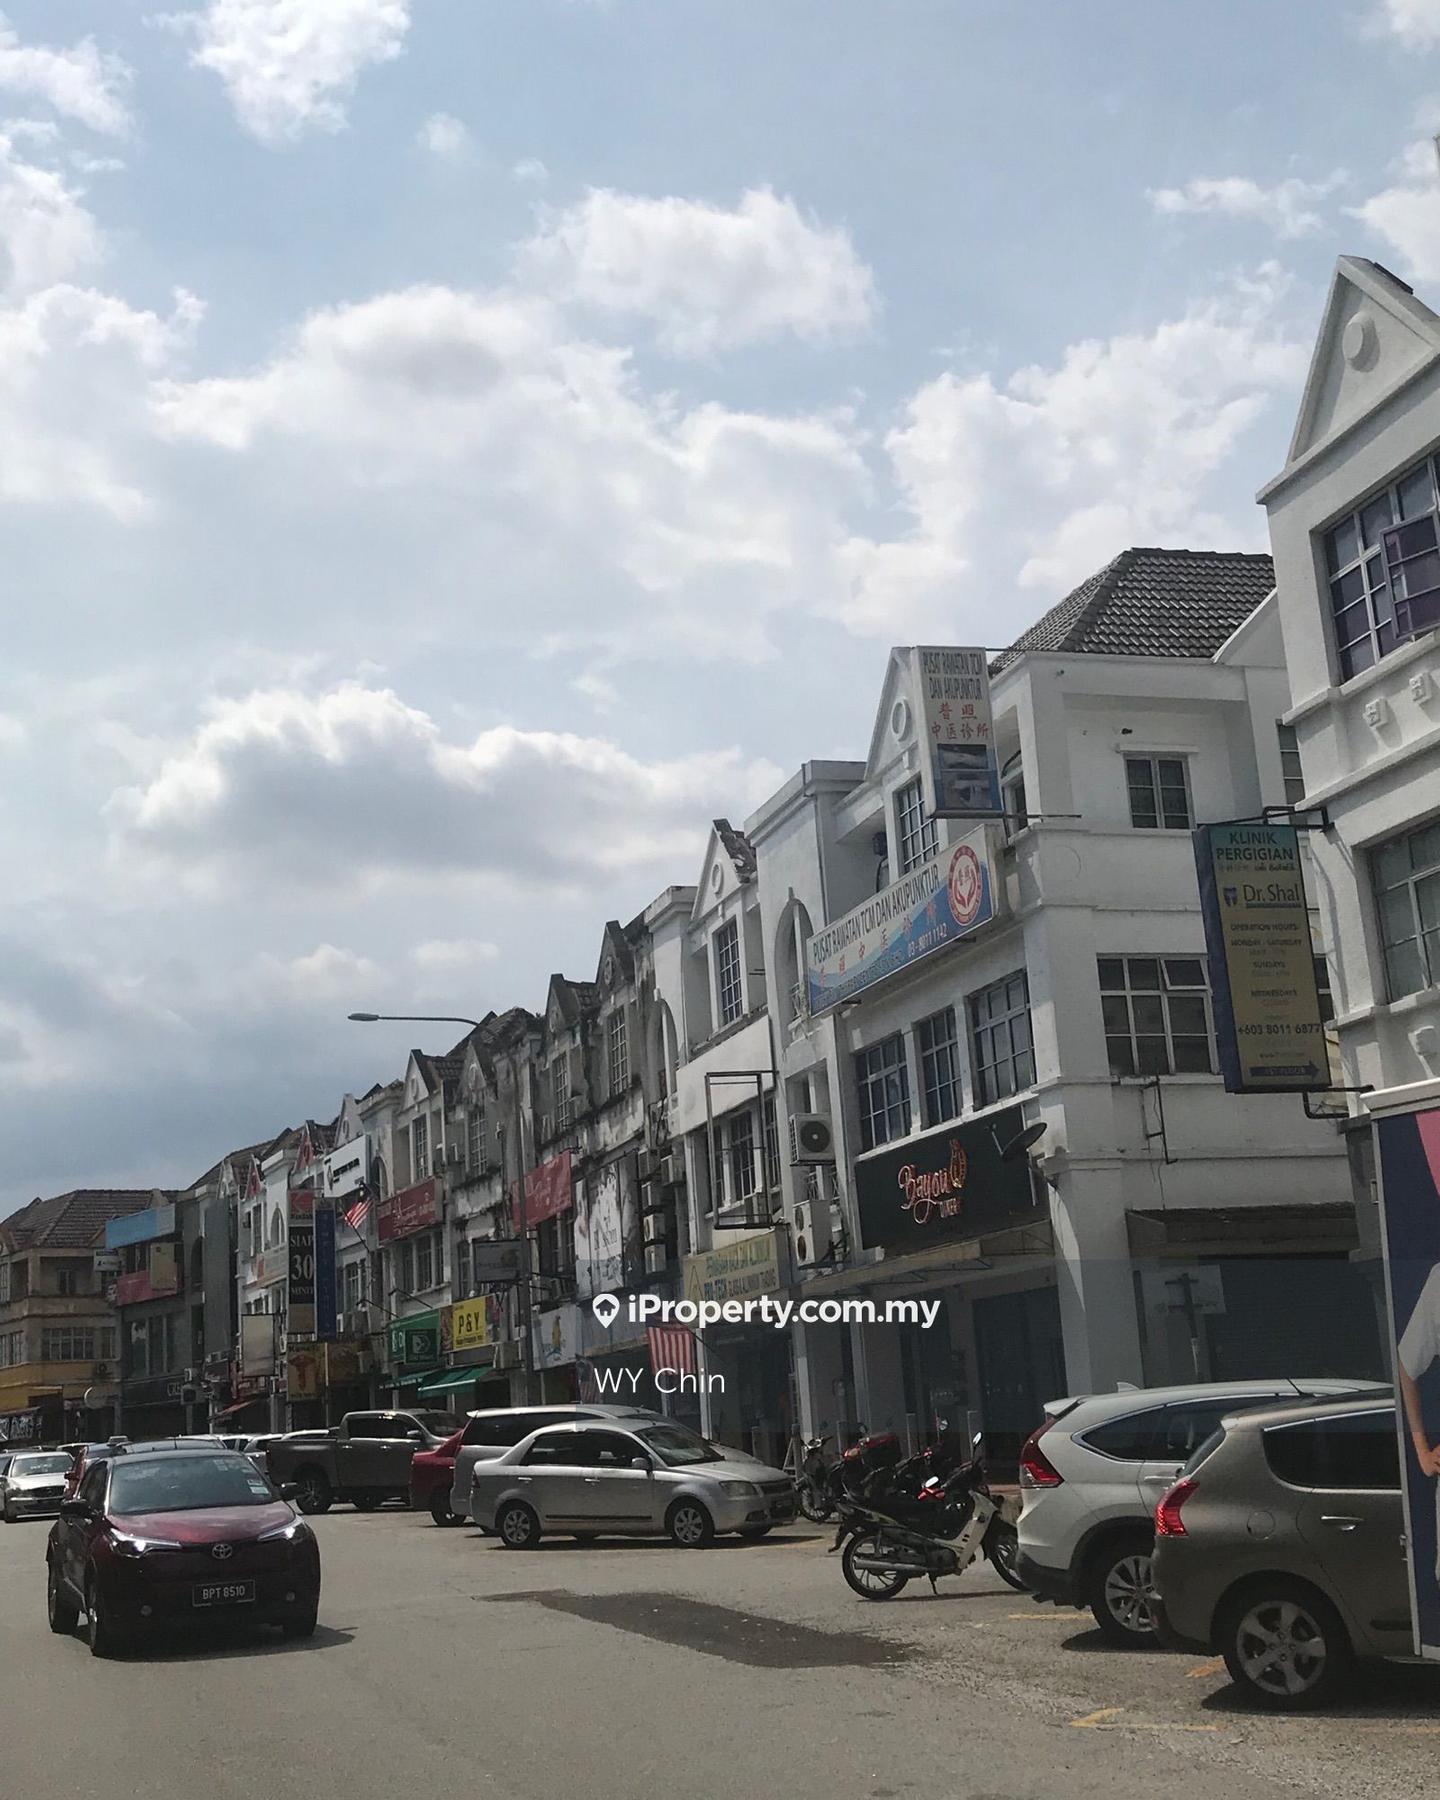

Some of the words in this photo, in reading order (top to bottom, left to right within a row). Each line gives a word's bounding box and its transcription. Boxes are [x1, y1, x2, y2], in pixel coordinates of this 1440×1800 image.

[923, 652, 941, 674] PUSAT
[929, 677, 943, 699] DAN
[931, 721, 988, 740] 中医诊所
[1229, 831, 1277, 844] KLINIK
[1216, 847, 1294, 860] PERGIGIAN
[812, 932, 832, 965] PUSAT
[832, 916, 861, 955] RAWATAN
[860, 905, 877, 937] TCM
[875, 896, 893, 928] DAN
[892, 863, 940, 917] AKUPUNKTUR
[1238, 1024, 1263, 1035] +603
[1295, 1023, 1320, 1034] 6877
[898, 1165, 952, 1224] Bayou
[291, 1254, 314, 1280] 30
[202, 1587, 221, 1600] BPT
[223, 1585, 246, 1598] 8510
